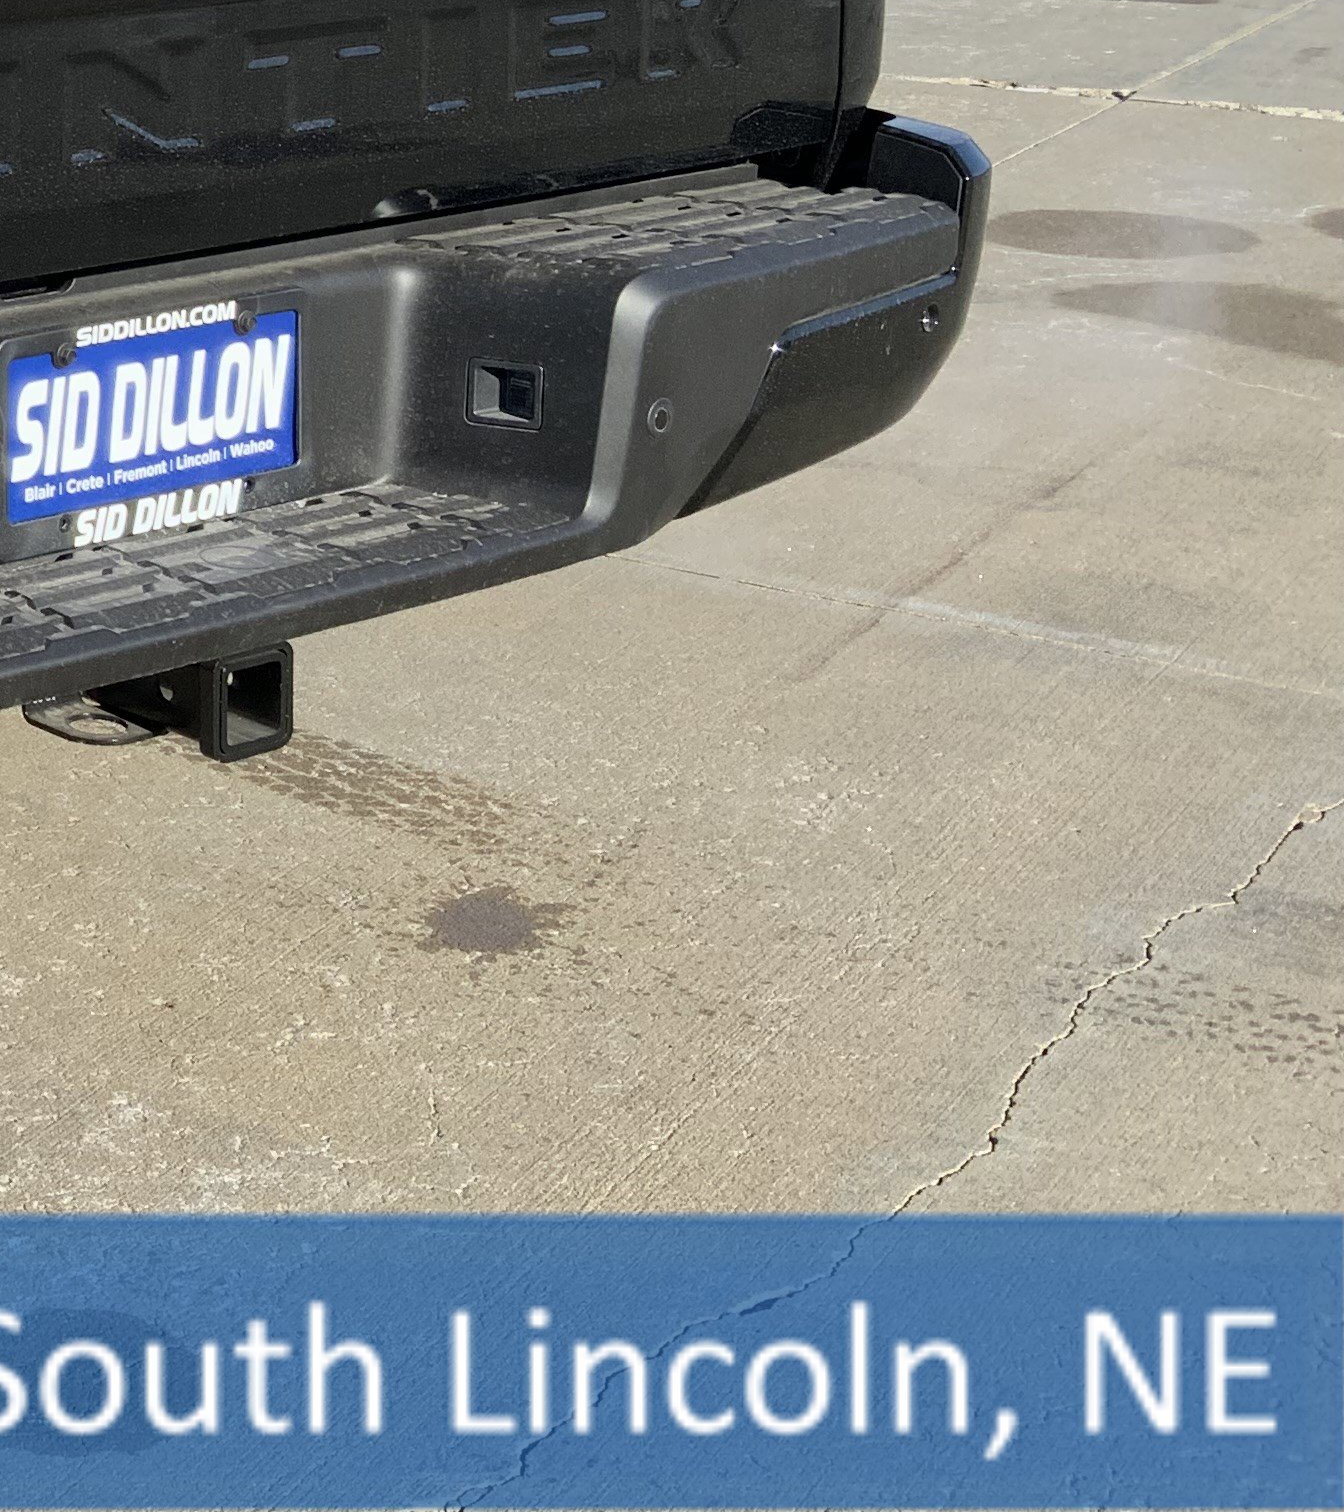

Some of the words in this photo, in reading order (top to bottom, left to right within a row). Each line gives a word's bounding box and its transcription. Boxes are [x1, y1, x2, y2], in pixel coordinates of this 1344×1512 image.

[75, 300, 237, 348] SIDDILLON.COM
[11, 370, 101, 484] SID
[108, 334, 292, 464] DILLON
[24, 484, 57, 504] Blair
[65, 475, 105, 495] Crete
[113, 460, 168, 486] Fremont
[175, 450, 222, 471] Lincoln
[229, 438, 275, 460] Wahoo
[74, 507, 127, 548] SID
[132, 478, 244, 535] DILLON
